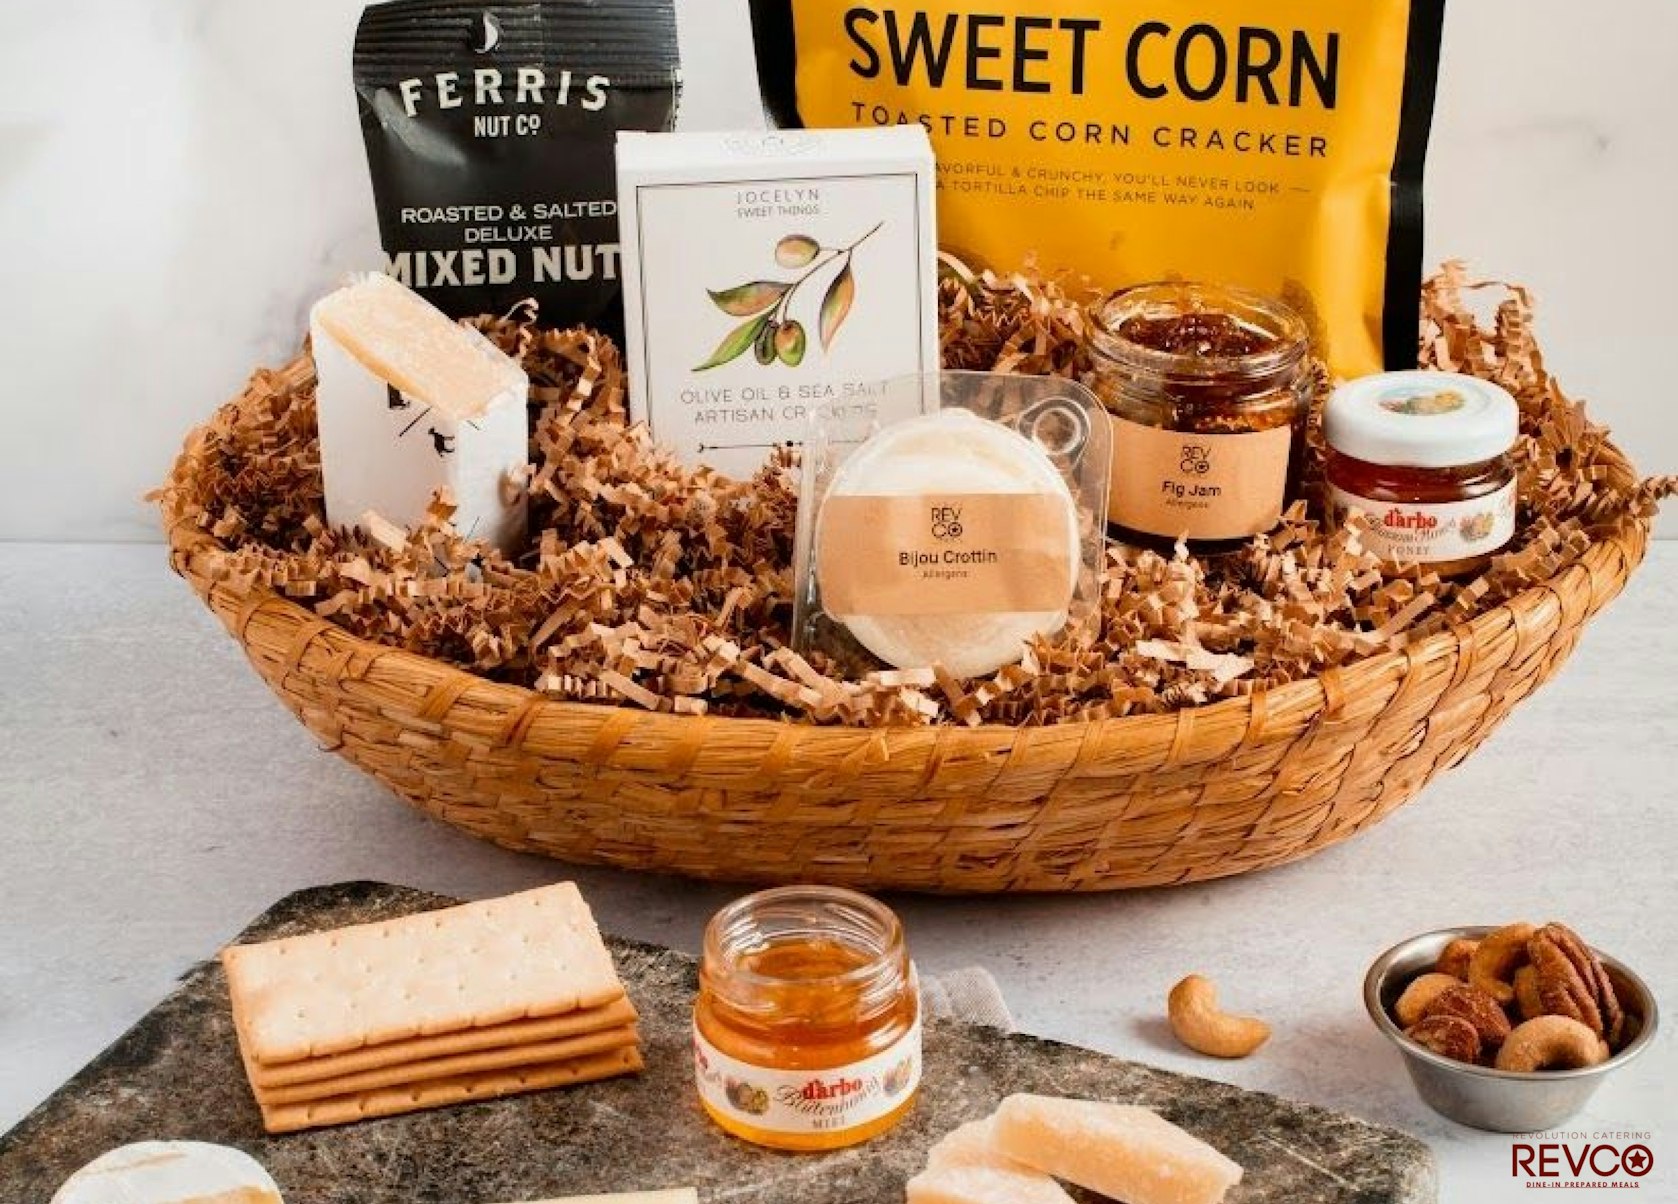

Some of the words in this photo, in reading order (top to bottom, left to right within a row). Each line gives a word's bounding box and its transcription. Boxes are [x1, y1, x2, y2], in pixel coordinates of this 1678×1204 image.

[844, 8, 1099, 94] SWEET
[1125, 22, 1340, 109] CORN
[399, 68, 611, 117] FERRIS
[474, 115, 511, 138] NUT
[851, 101, 1006, 138] TOASTED
[1029, 120, 1130, 145] CORN
[1153, 126, 1327, 157] CRACKER
[935, 162, 1007, 176] AVORFUL
[1011, 166, 1021, 178] &
[1113, 172, 1169, 187] YOU'LL
[1176, 175, 1229, 190] NEVER
[1235, 180, 1280, 193] LOOK
[736, 189, 819, 204] JOCELYN
[952, 180, 1026, 195] TORTILLA
[1033, 185, 1069, 198] CHIP
[1077, 188, 1107, 201] THE
[1113, 190, 1156, 204] SAME
[1164, 194, 1198, 205] WAY
[1203, 196, 1254, 210] AGAIN
[401, 206, 504, 223] ROASTED
[509, 205, 526, 220] &
[533, 201, 618, 219] SALTED
[464, 224, 553, 243] DELUXE
[383, 248, 517, 288] MIXED
[532, 243, 621, 283] NUT
[680, 388, 733, 404] OLIVE
[741, 387, 767, 401] OIL
[778, 385, 790, 399] &
[798, 384, 835, 398] SEA
[694, 408, 774, 424] ARTISAN
[1161, 480, 1185, 498] Fig
[1188, 483, 1222, 497] Jam
[931, 507, 962, 522] REV
[898, 551, 939, 568] Bijou
[943, 549, 998, 564] Crottin
